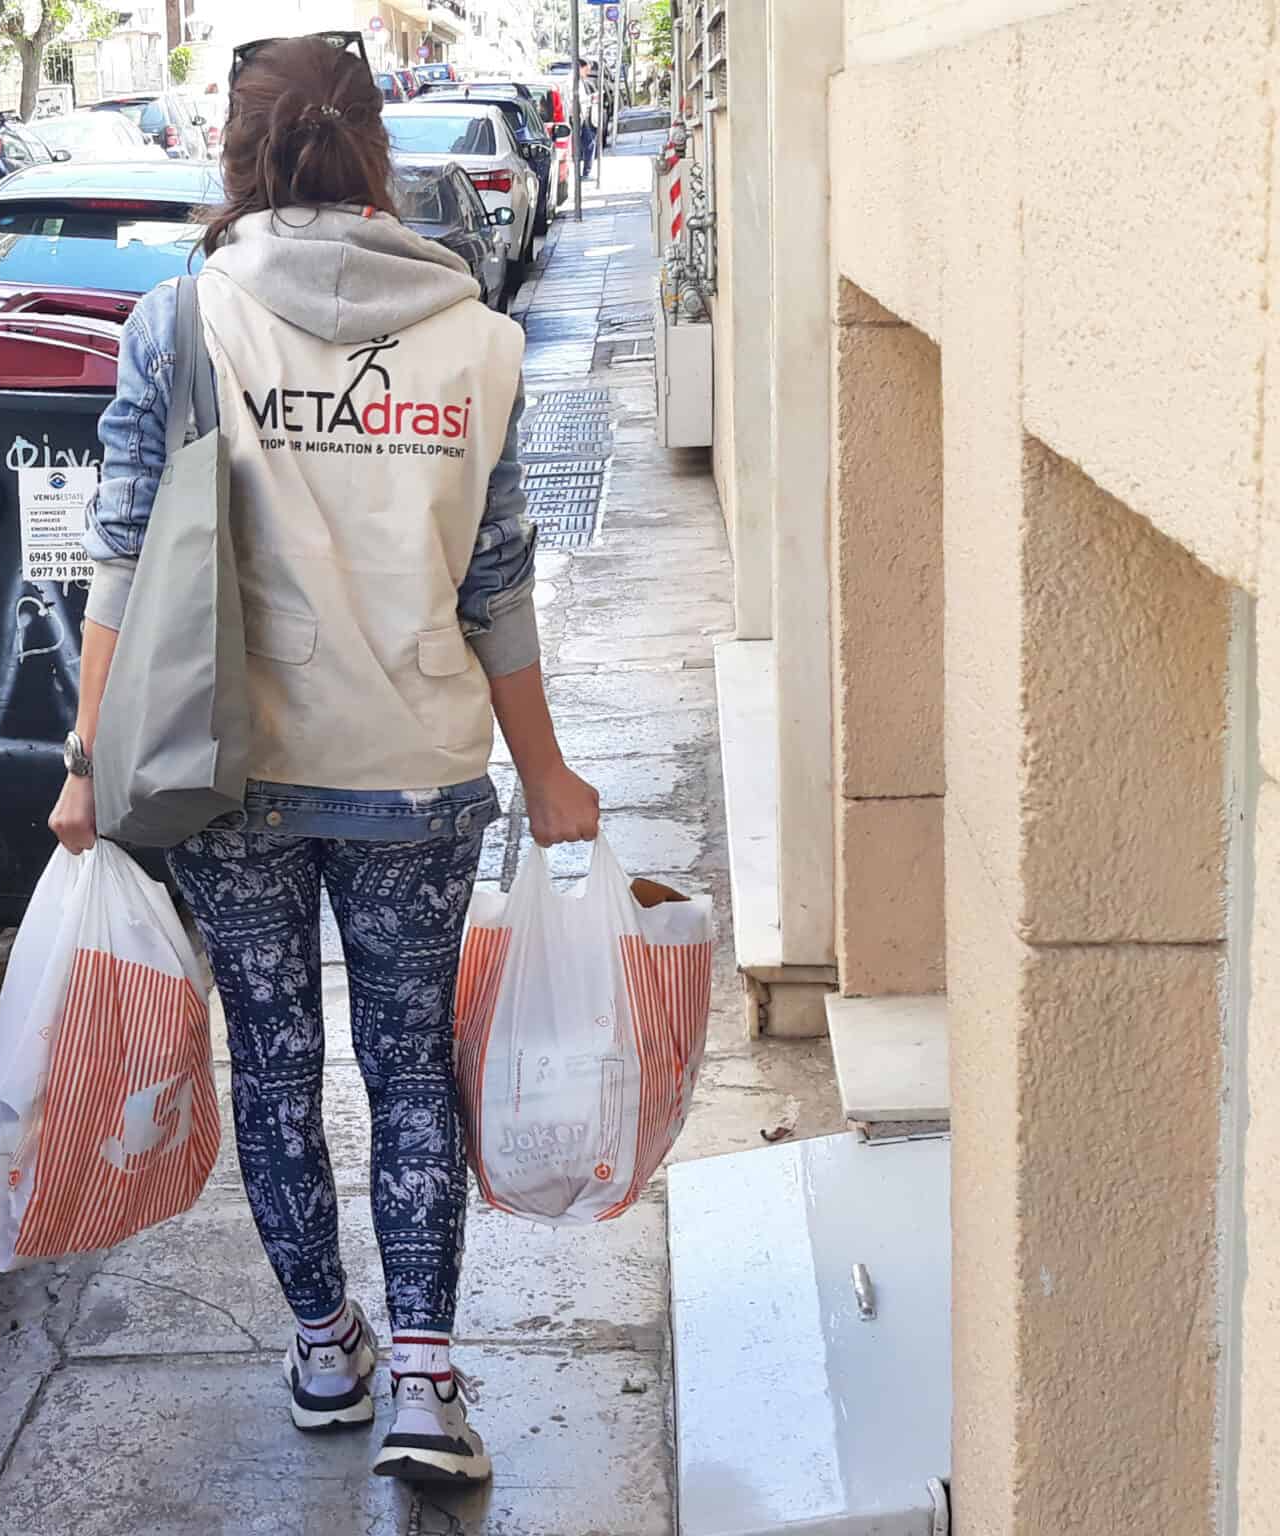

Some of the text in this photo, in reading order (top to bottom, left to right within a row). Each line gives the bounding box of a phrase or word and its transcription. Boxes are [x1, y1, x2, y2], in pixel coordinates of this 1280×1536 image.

[243, 387, 472, 438] METAdrasi
[306, 440, 372, 454] MIGRATION
[376, 444, 384, 454] &
[388, 443, 465, 459] DEVELOPMENT
[29, 552, 52, 562] 6945
[55, 552, 67, 561] 90
[30, 566, 94, 577] 6977 91 8780
